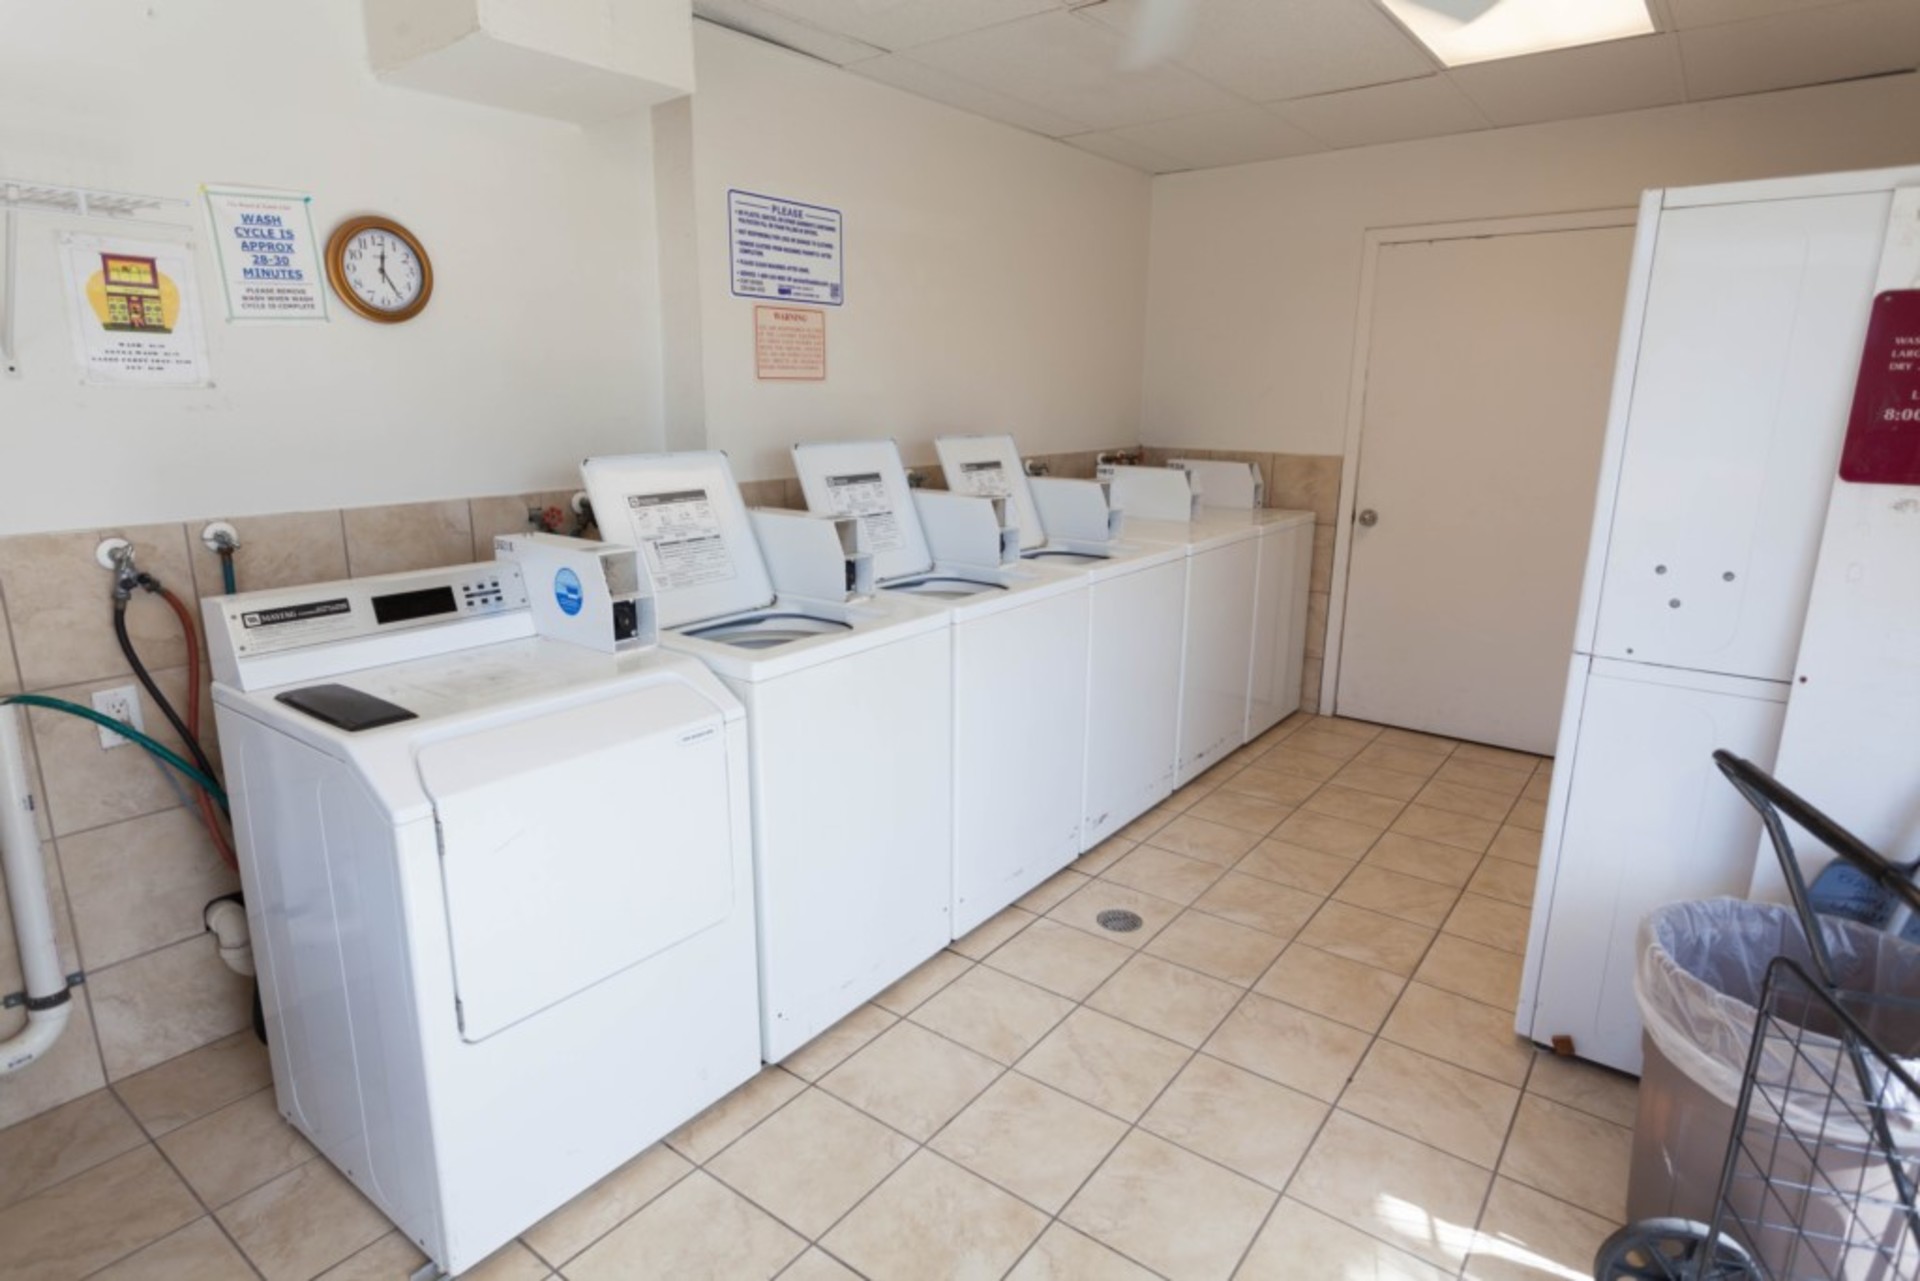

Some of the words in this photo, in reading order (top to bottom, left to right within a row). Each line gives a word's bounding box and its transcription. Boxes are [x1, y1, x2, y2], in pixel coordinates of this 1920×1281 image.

[771, 205, 803, 218] PLEASE
[240, 213, 282, 226] WASH
[234, 226, 275, 239] CYCLE
[279, 228, 295, 240] IS
[241, 240, 295, 253] APPROX
[251, 254, 290, 266] 28-30
[243, 267, 304, 280] MINUTES
[245, 287, 275, 295] PLEASE
[773, 312, 807, 322] WARNING
[1889, 362, 1912, 370] DRY
